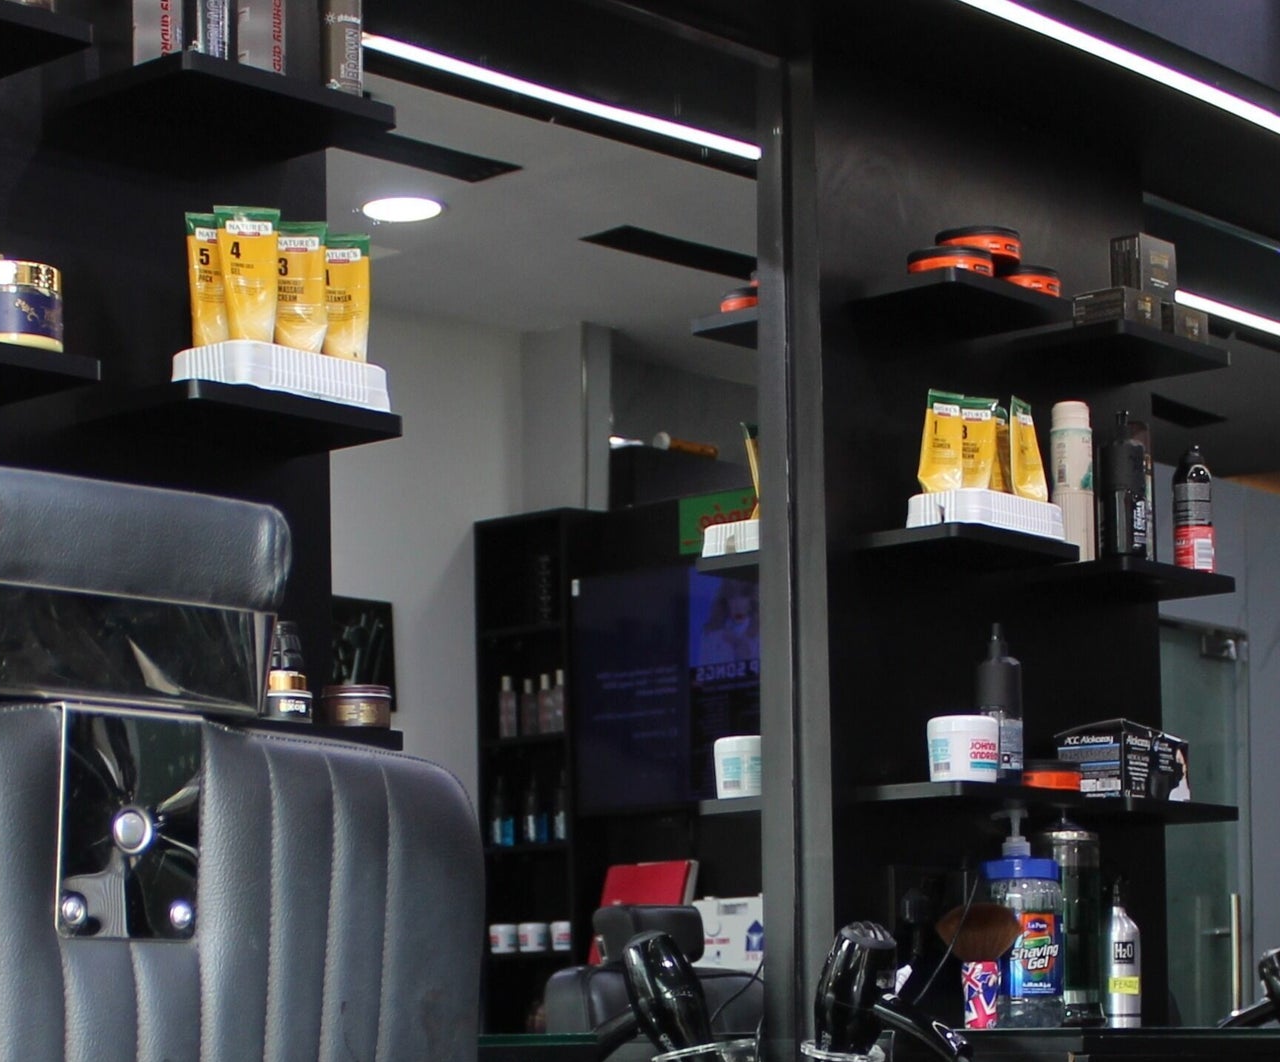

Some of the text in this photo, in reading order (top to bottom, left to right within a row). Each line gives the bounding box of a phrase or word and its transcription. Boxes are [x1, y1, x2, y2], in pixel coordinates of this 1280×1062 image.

[345, 28, 359, 79] BROWN
[199, 248, 210, 266] 5
[230, 241, 241, 259] 4
[278, 257, 289, 276] 3
[1011, 944, 1059, 961] Shaving
[1027, 956, 1049, 970] Gel
